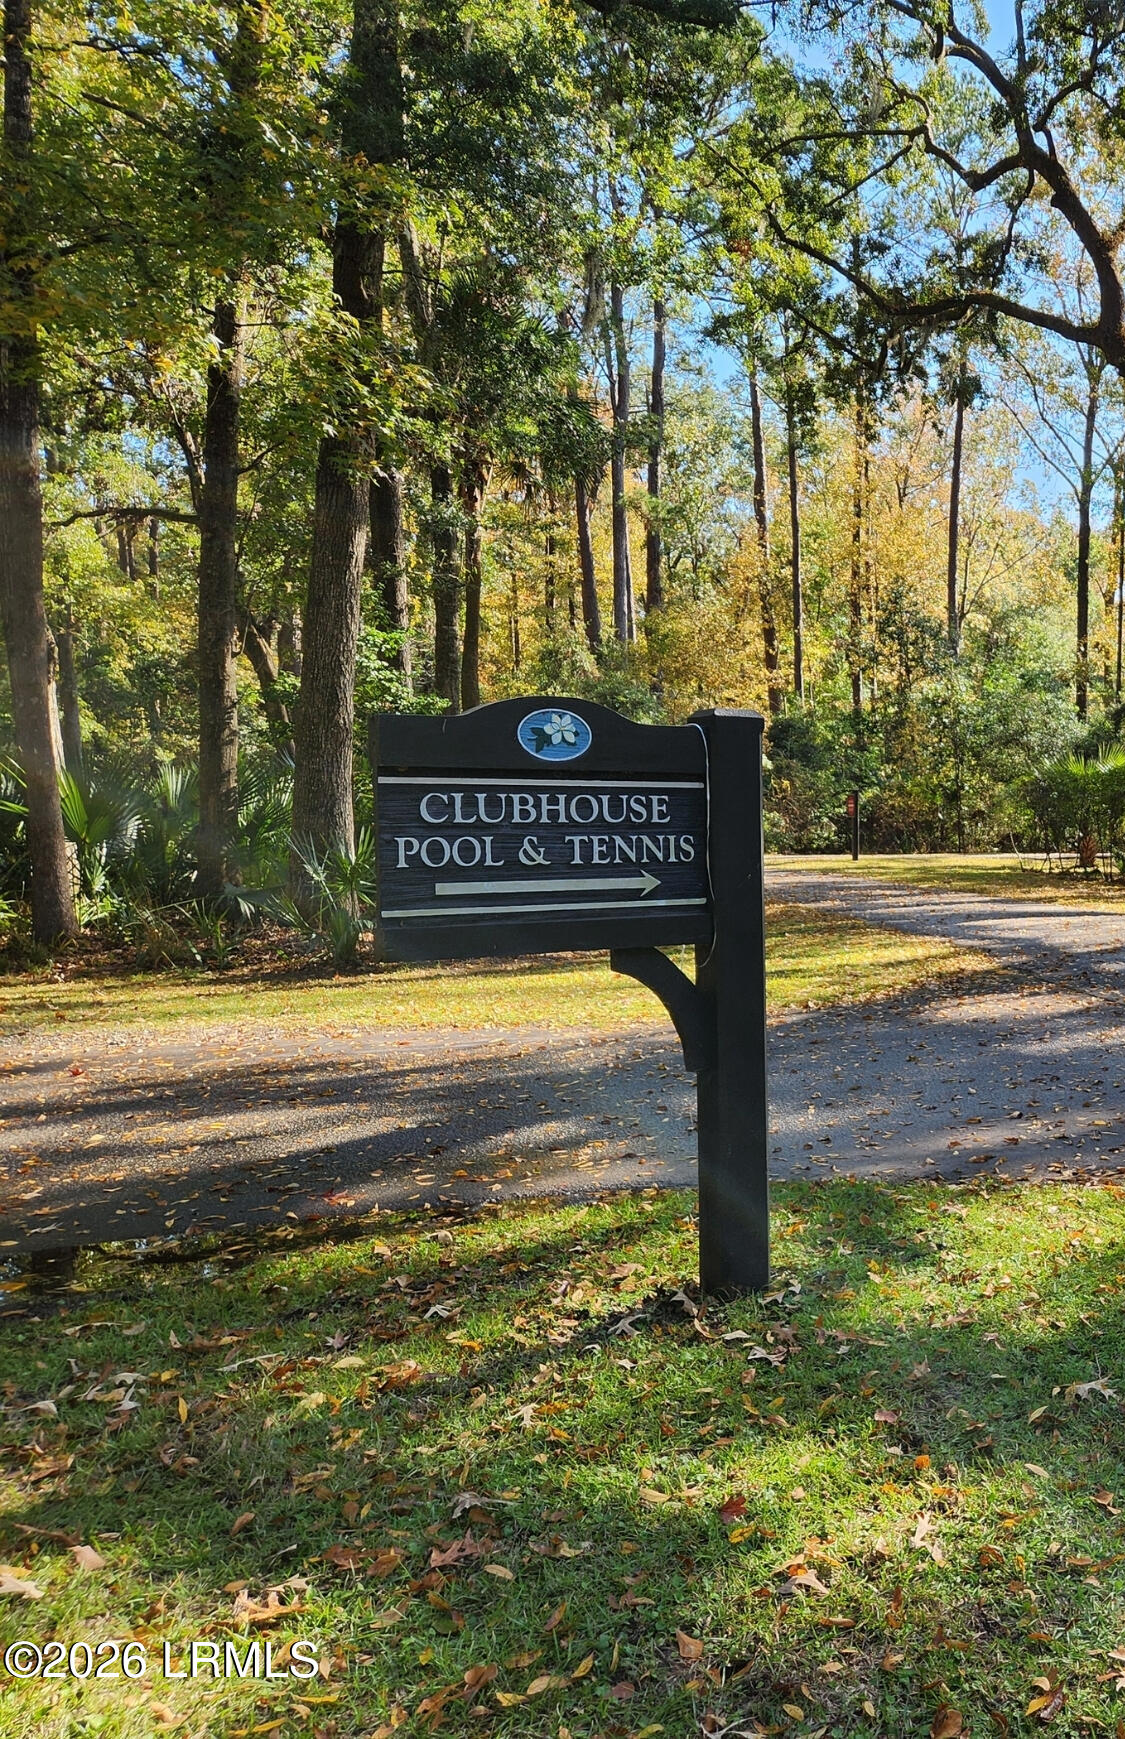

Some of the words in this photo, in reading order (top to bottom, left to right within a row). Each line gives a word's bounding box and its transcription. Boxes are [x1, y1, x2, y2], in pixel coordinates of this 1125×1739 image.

[419, 792, 671, 824] CLUBHOUSE
[393, 836, 505, 868] POOL
[518, 835, 552, 866] &
[564, 834, 695, 865] TENNIS
